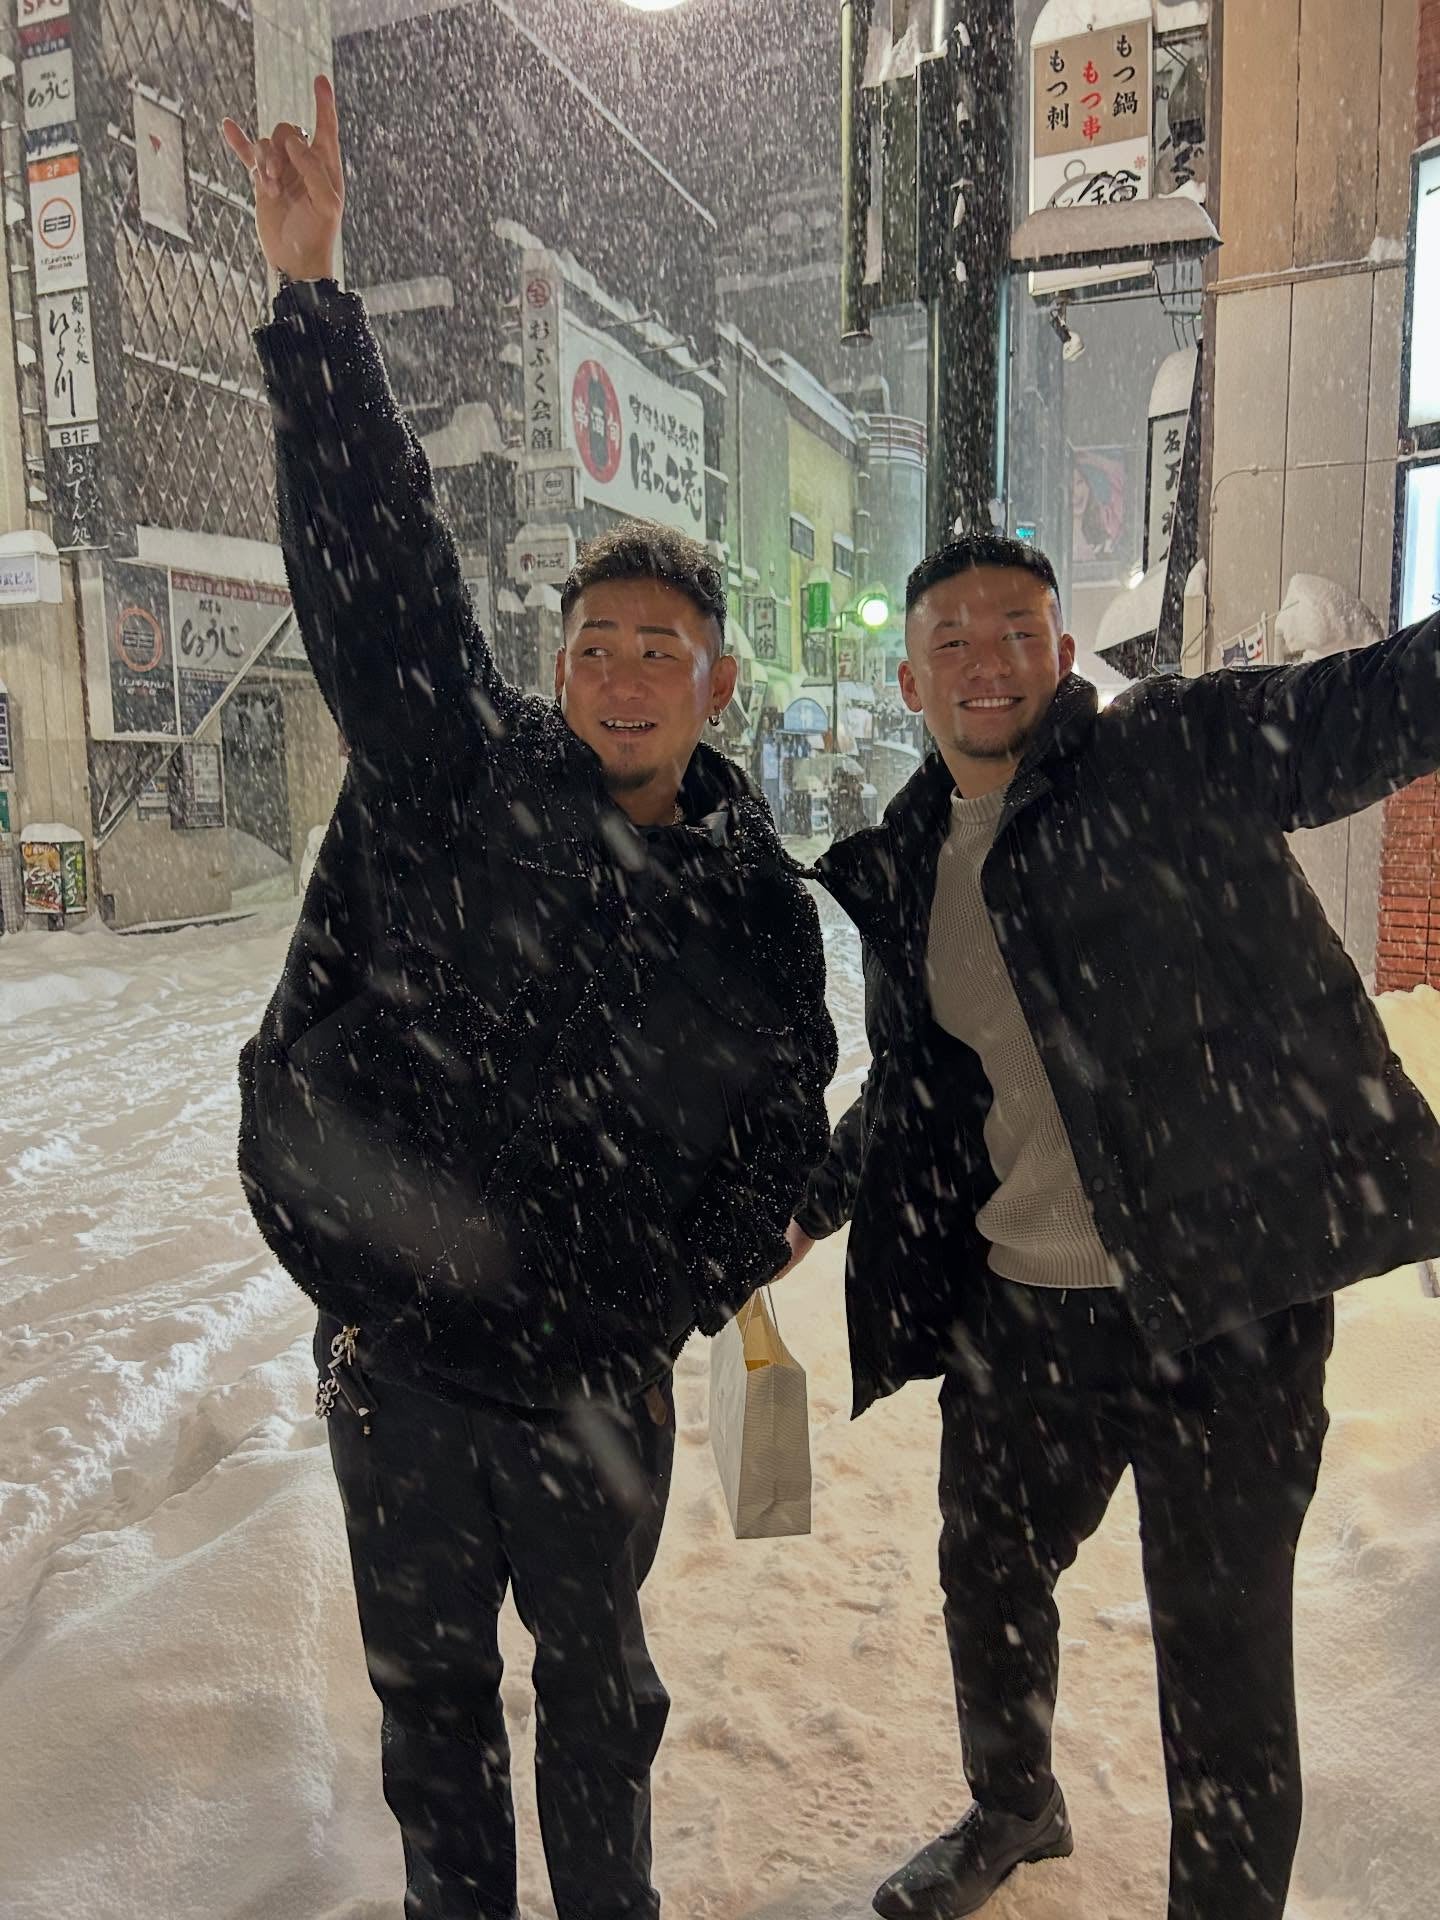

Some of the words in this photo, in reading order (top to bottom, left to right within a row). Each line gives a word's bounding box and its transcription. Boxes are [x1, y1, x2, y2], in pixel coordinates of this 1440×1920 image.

[1046, 49, 1070, 131] もつ刺
[1080, 60, 1102, 141] もつ串
[1112, 34, 1138, 117] もつ鍋
[47, 164, 60, 177] 2F
[528, 319, 554, 449] おふく会館
[60, 428, 90, 445] B1F
[65, 453, 91, 546] おでん処
